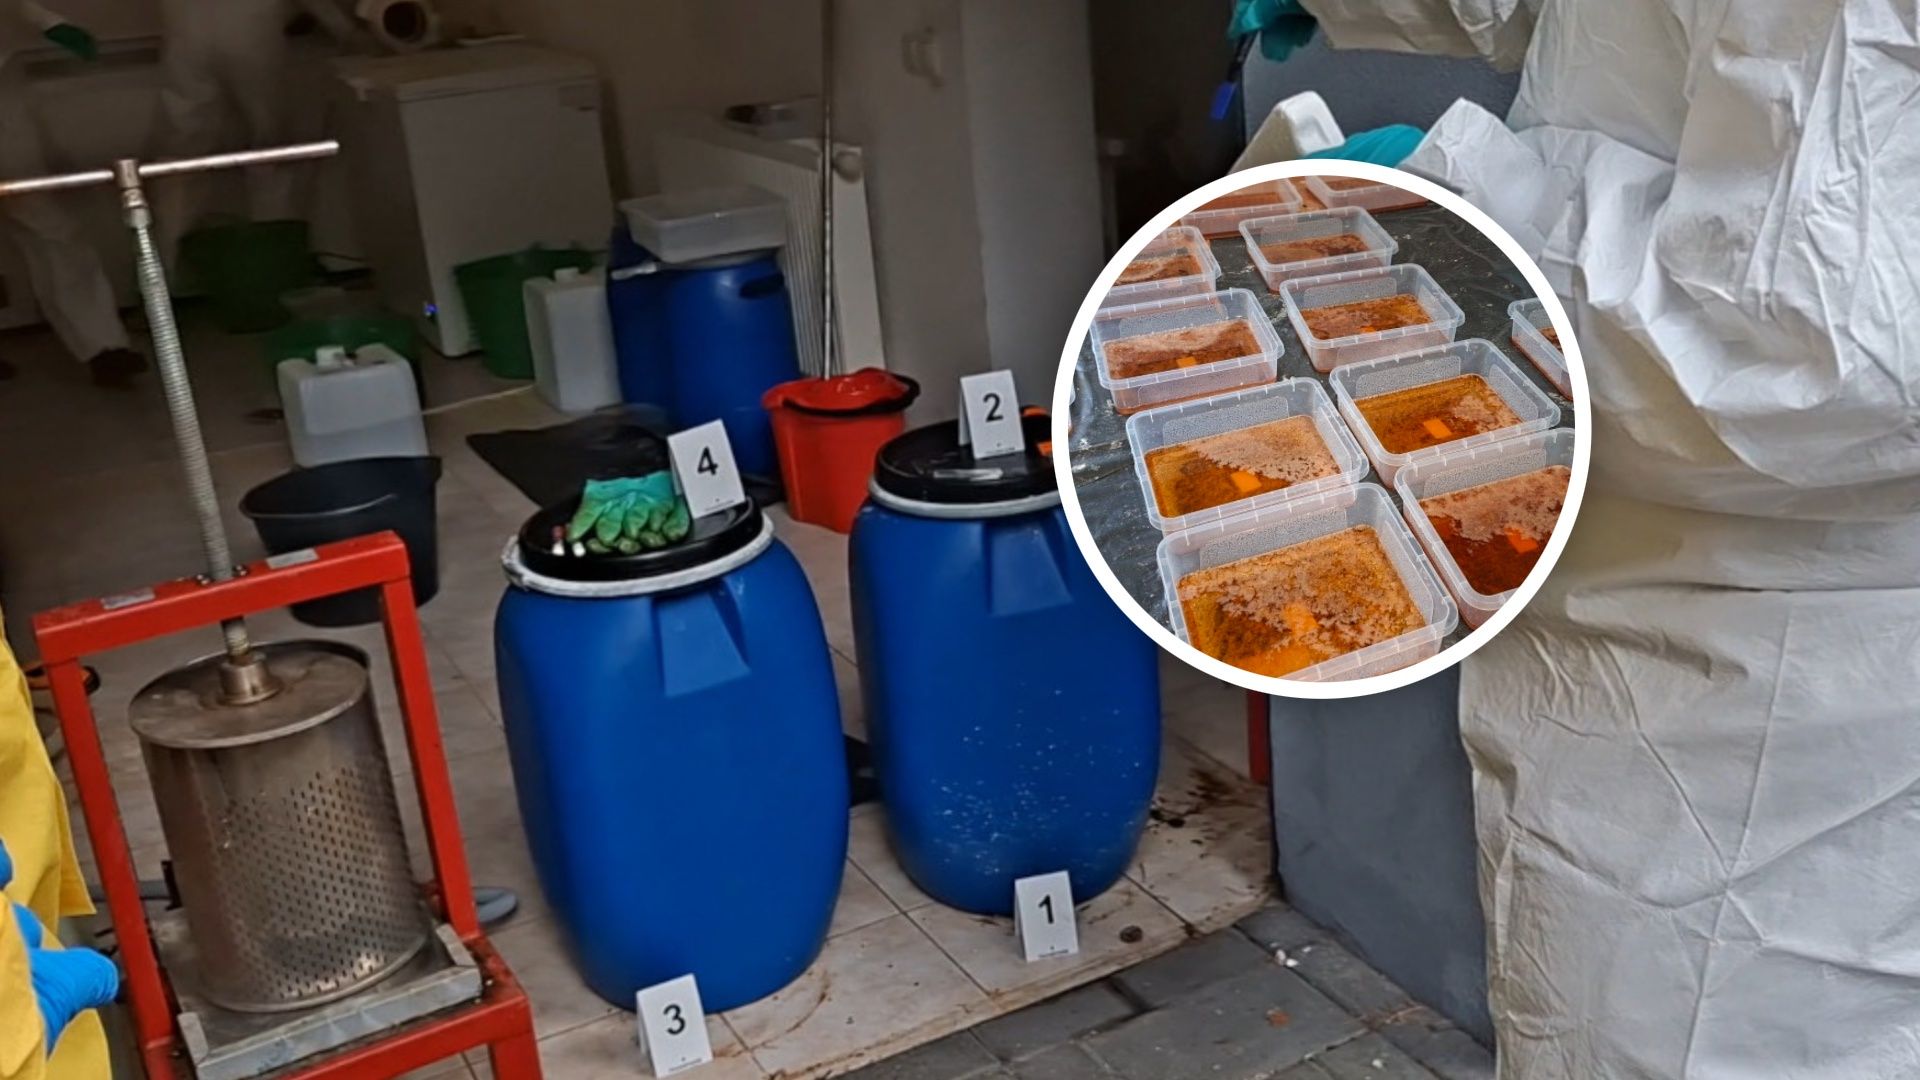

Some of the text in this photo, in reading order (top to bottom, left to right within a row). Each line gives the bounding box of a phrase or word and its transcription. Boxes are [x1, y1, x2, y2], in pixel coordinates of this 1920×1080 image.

[983, 392, 1004, 423] 2
[697, 447, 719, 476] 4
[1038, 894, 1055, 925] 1
[663, 1004, 686, 1035] 3
